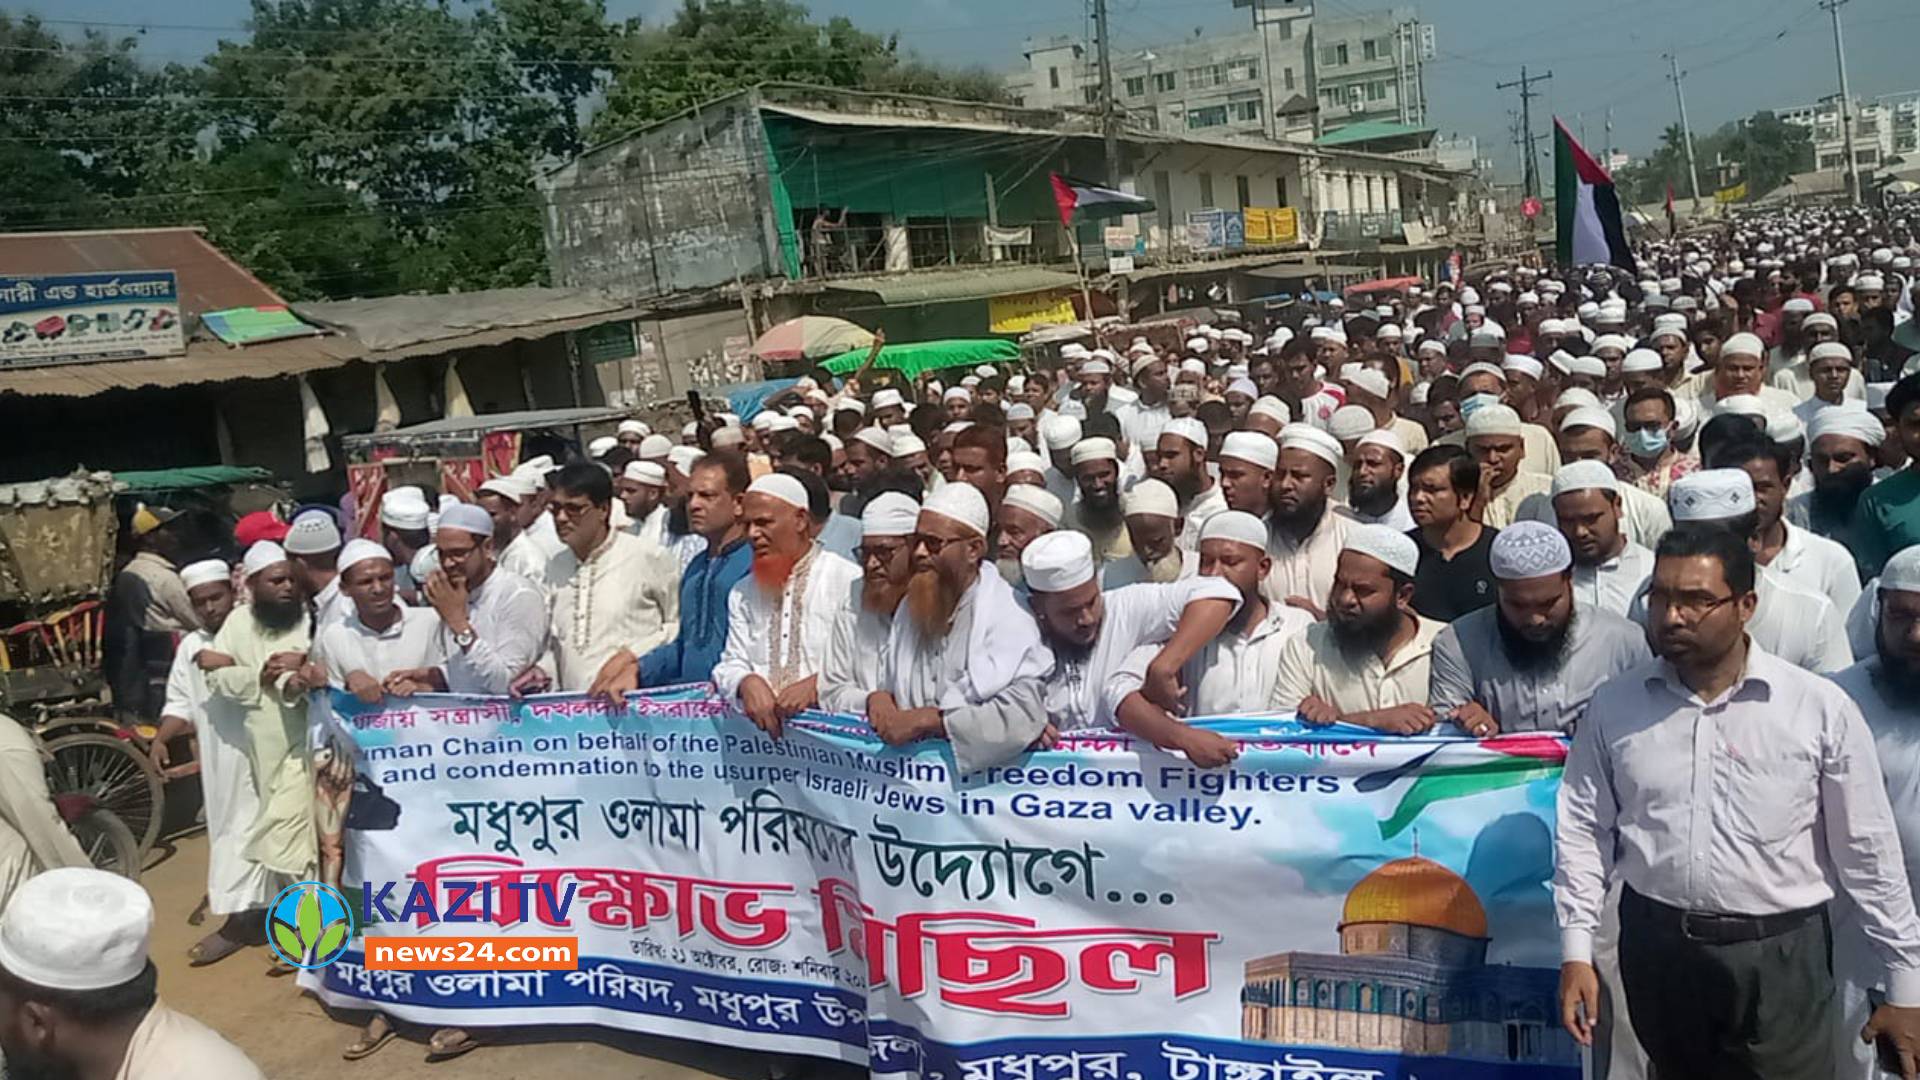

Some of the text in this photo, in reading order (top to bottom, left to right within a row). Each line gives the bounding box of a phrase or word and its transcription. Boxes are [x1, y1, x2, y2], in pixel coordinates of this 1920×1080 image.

[382, 756, 1262, 831] and condemnation to the usurper Israeli Jews in Gaza valley.
[442, 736, 523, 757] Chain
[533, 737, 568, 752] on
[578, 731, 649, 751] behalf
[653, 733, 677, 752] of
[682, 734, 719, 752] the
[724, 733, 843, 767] Palestinian
[846, 750, 945, 783] Muslim
[1160, 766, 1341, 797] Fighters
[446, 795, 584, 855] মধুপুর
[601, 795, 705, 852] ওলামা
[719, 788, 858, 870] পরিষদের
[405, 856, 794, 946] বিক্ষোভ
[334, 962, 415, 999] মধুপুর
[427, 969, 550, 998] ওলামা
[565, 964, 683, 1013] পরিষদ,
[693, 986, 803, 1030] মধুপুর
[671, 948, 687, 963] ২১
[791, 956, 840, 980] শনিবার
